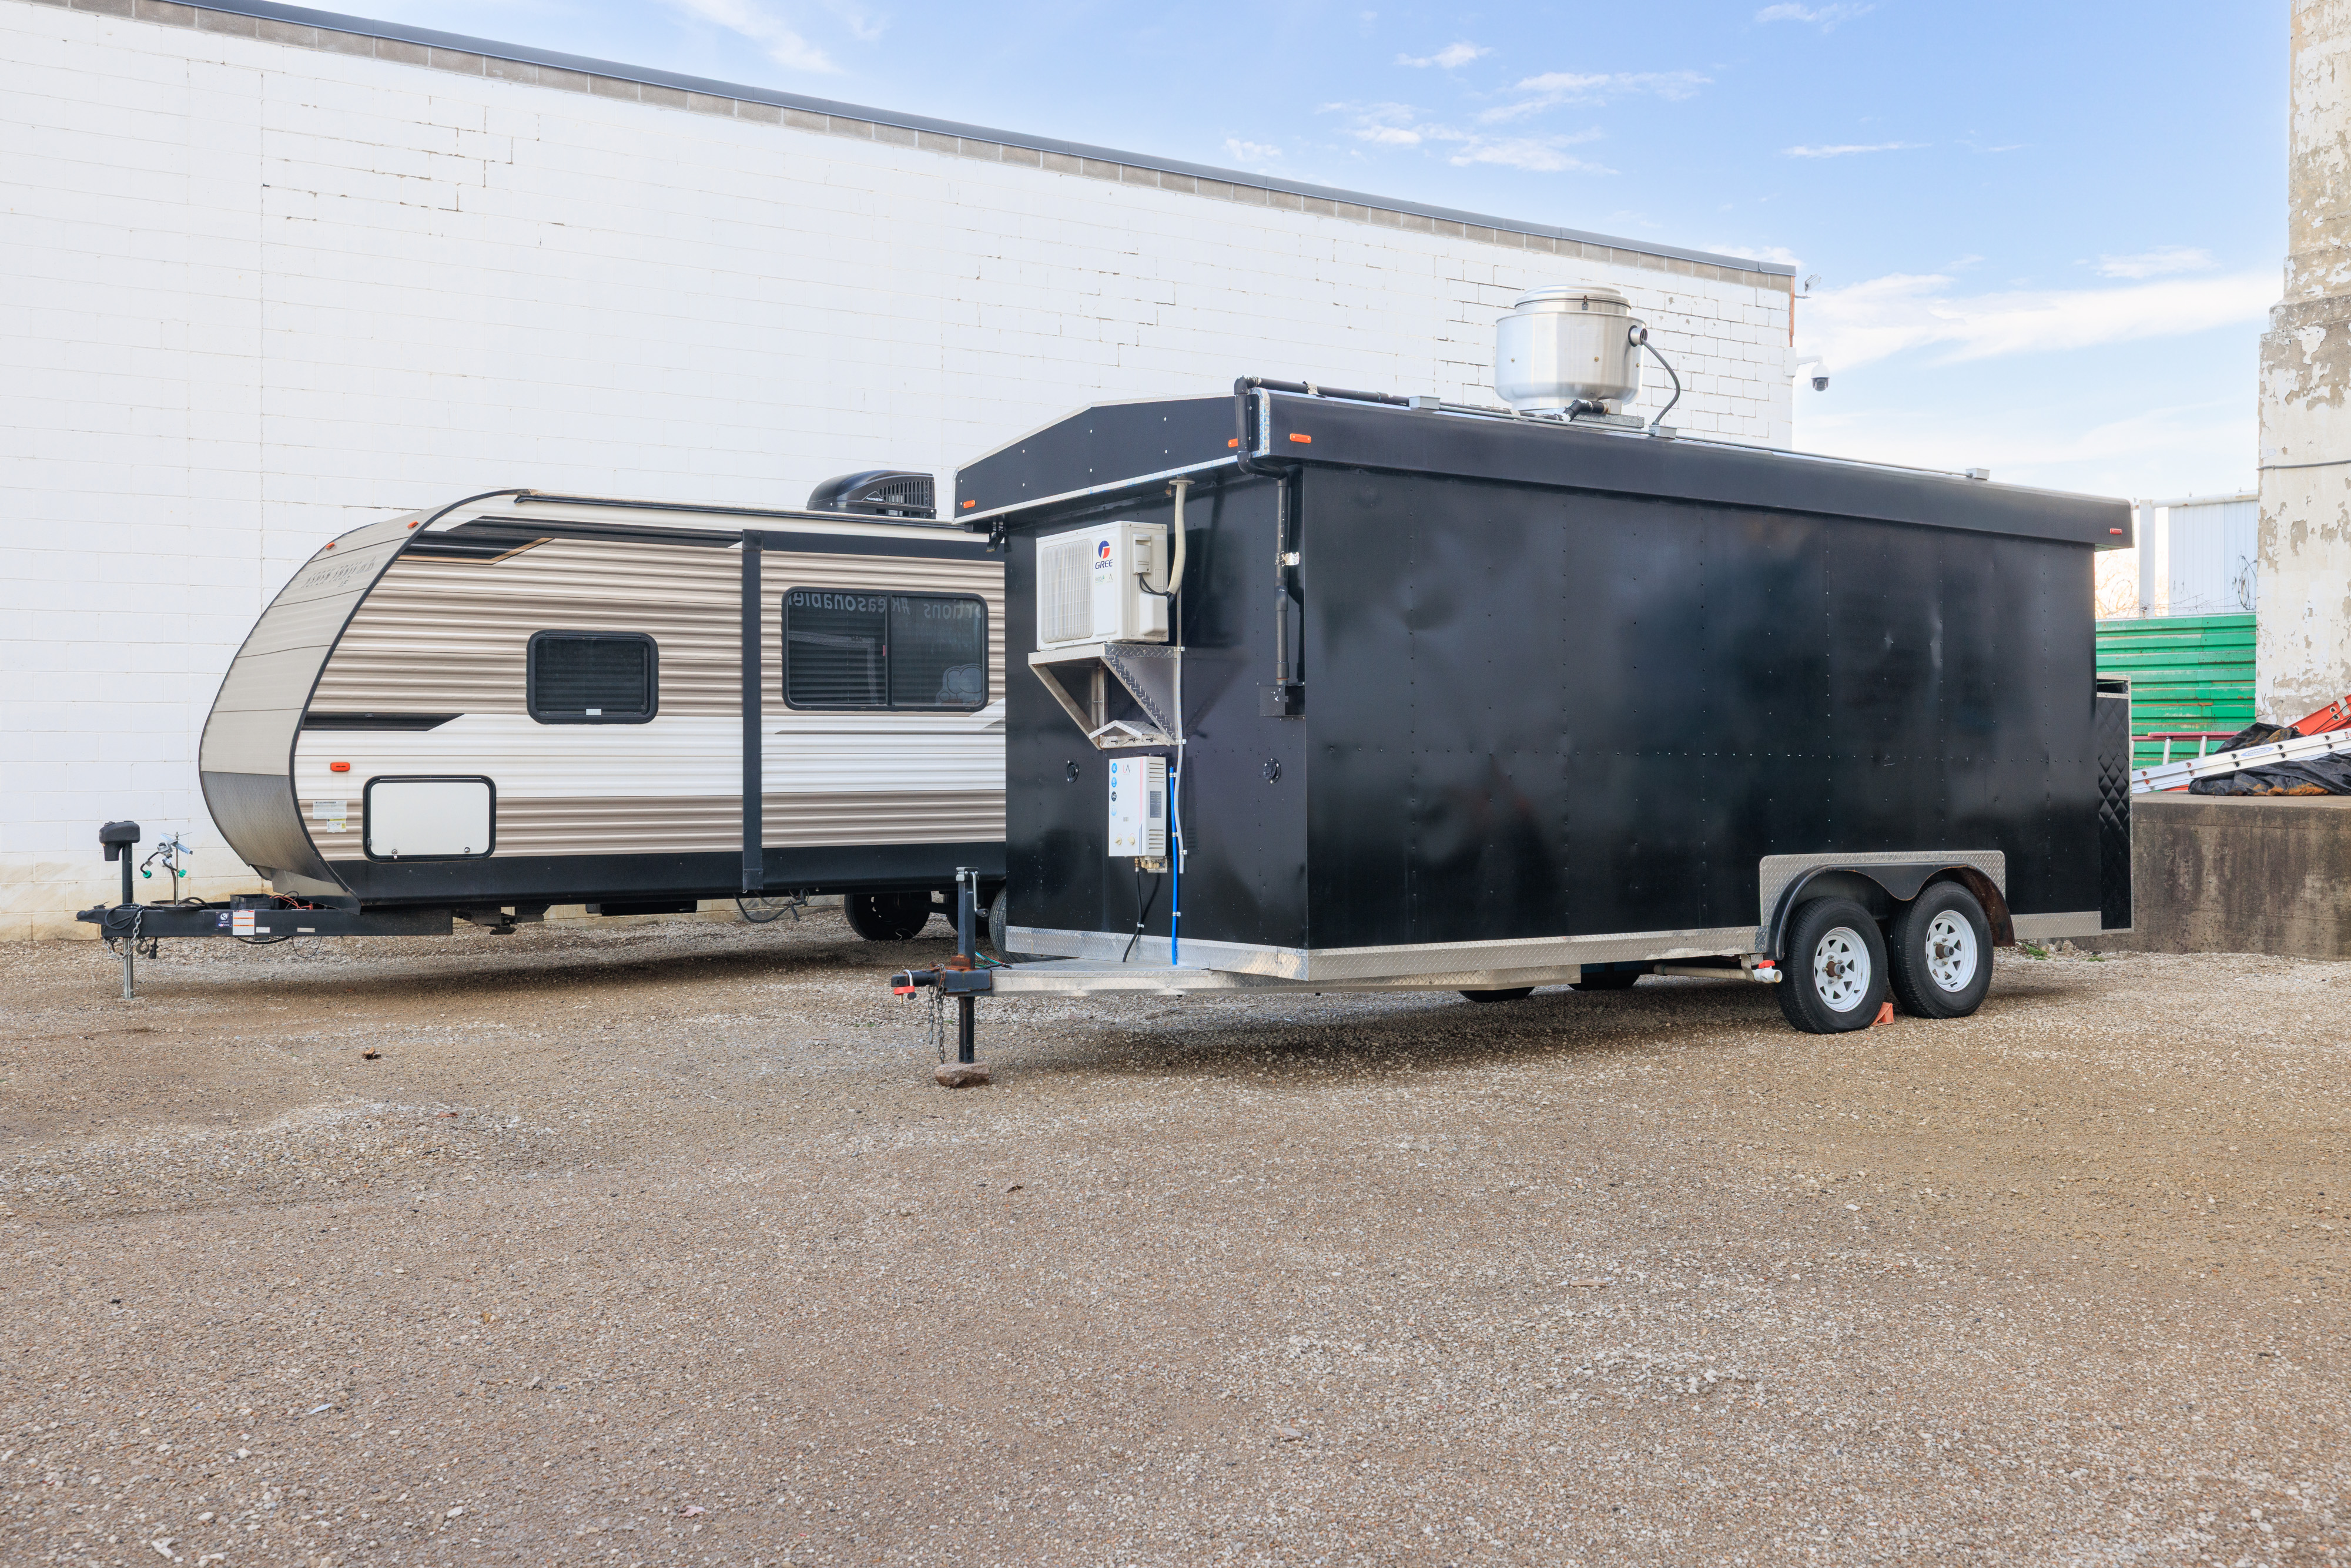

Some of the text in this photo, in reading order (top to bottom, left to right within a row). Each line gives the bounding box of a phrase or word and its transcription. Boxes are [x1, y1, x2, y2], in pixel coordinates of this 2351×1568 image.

[1095, 559, 1113, 569] GREE
[300, 561, 361, 588] ASPEN TRAIL
